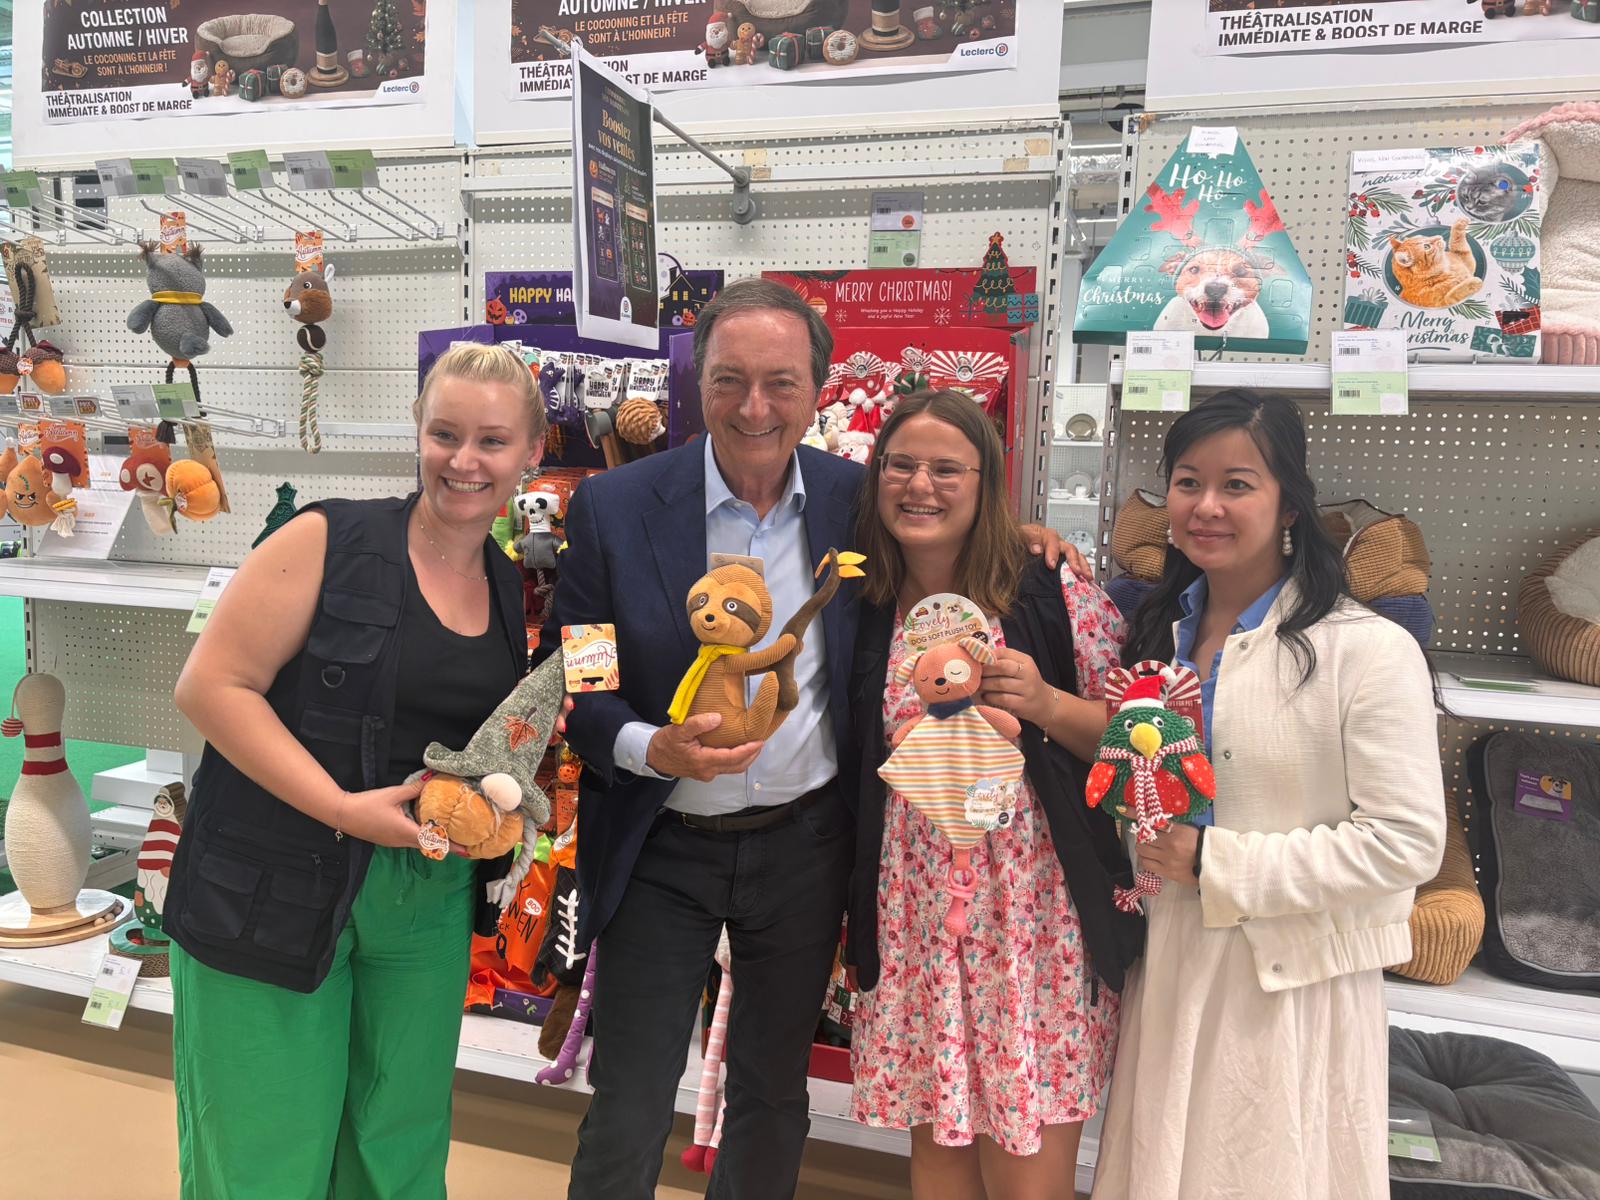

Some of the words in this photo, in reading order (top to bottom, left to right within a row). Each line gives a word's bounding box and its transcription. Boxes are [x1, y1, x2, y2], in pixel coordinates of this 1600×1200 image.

[81, 6, 167, 28] COLLECTION
[558, 0, 639, 16] AUTOMNE
[575, 21, 585, 32] LE
[587, 16, 639, 30] COCOONING
[640, 15, 651, 25] ET
[653, 14, 665, 25] LA
[667, 10, 689, 24] FÊTE
[1220, 8, 1374, 30] THÉÂTRALISATION
[67, 30, 134, 50] AUTOMNE
[138, 29, 142, 47] /
[146, 27, 189, 46] HIVER
[588, 31, 611, 44] SONT
[613, 28, 620, 41] À
[622, 28, 670, 41] L'HONNEUR
[1218, 29, 1311, 47] IMMÉDIATE
[1314, 28, 1327, 41] &
[1331, 24, 1389, 40] BOOST
[1394, 23, 1416, 37] DE
[1420, 20, 1483, 35] MARGE
[84, 56, 93, 65] LE
[94, 53, 137, 64] COCOONING
[138, 52, 146, 61] ET
[148, 51, 158, 61] LA
[159, 49, 176, 60] FÊTE
[960, 48, 994, 57] Leclerc
[97, 65, 116, 76] SONT
[118, 63, 123, 75] À
[125, 63, 164, 75] L'HONNEUR
[643, 72, 658, 84] DE
[662, 69, 707, 83] MARGE
[46, 91, 132, 106] THÉÂTRALISATION
[383, 85, 409, 93] Leclerc
[47, 105, 99, 118] IMMÉDIATE
[101, 105, 107, 115] &
[110, 103, 141, 114] BOOST
[142, 102, 155, 112] DE
[157, 100, 192, 111] MARGE
[1169, 163, 1213, 189] Ho
[1217, 170, 1247, 190] Ho
[1198, 184, 1228, 203] Ho
[509, 287, 553, 304] HAPPY
[835, 281, 873, 303] MERRY
[879, 280, 953, 302] CHRISTMAS!
[1083, 285, 1166, 305] Christmas
[1400, 311, 1457, 332] Merry
[1406, 328, 1471, 345] ristmas
[911, 610, 950, 632] Lovely
[911, 636, 927, 646] DOG
[928, 632, 944, 641] SOFT
[945, 627, 964, 637] PLUSH
[965, 623, 978, 632] TOY
[564, 644, 617, 668] Autumn
[527, 900, 540, 913] BOO
